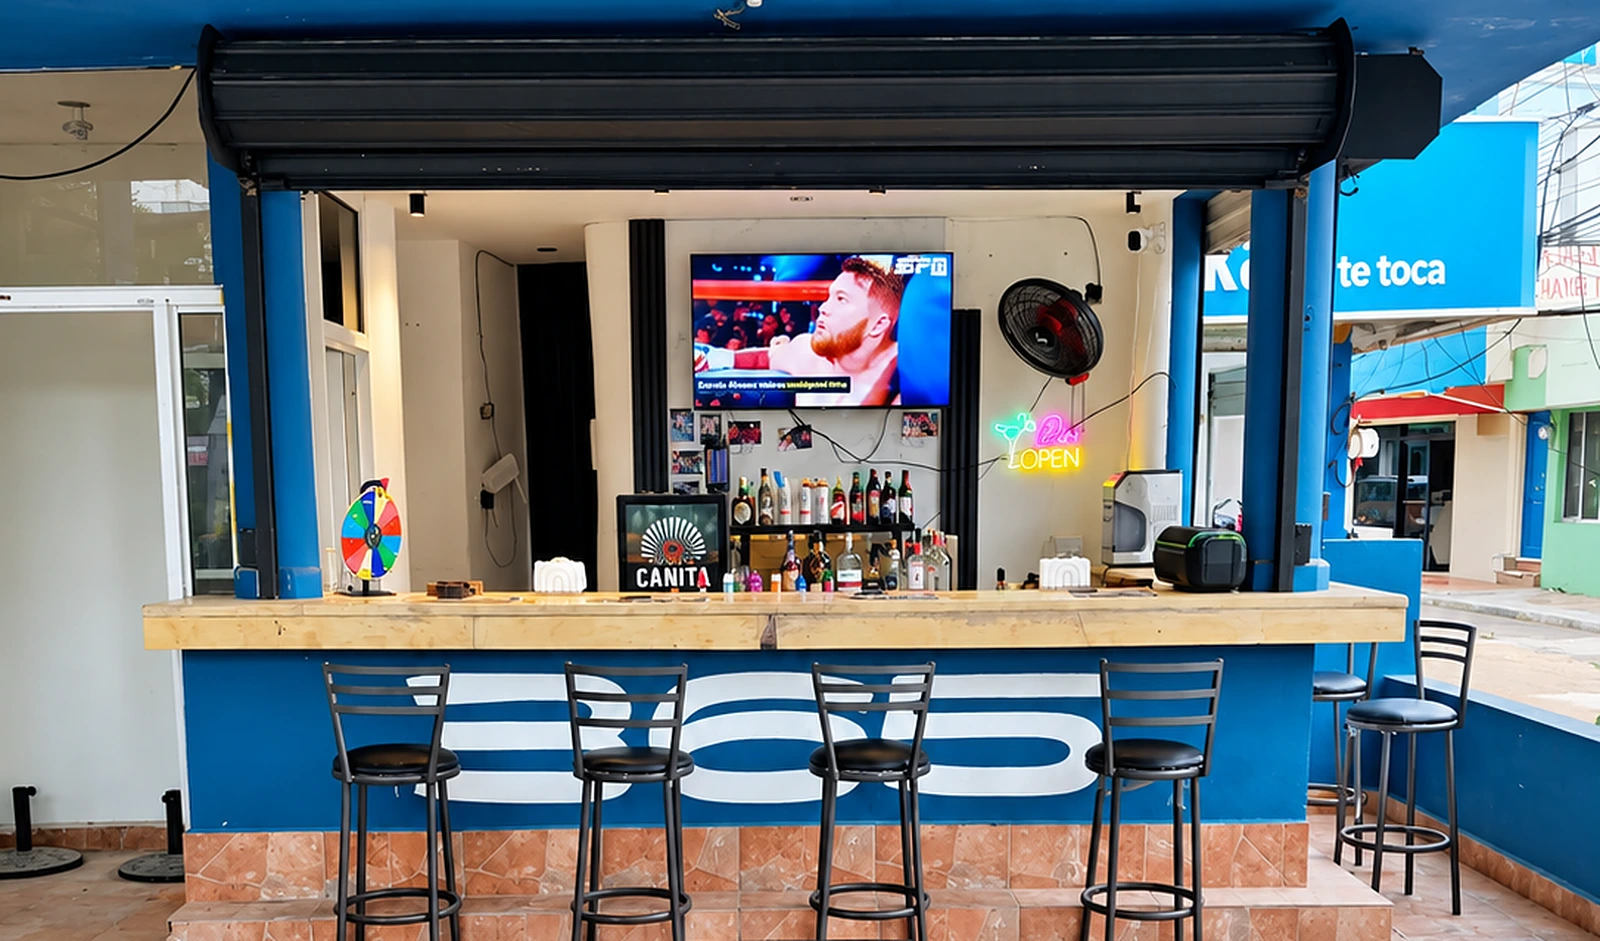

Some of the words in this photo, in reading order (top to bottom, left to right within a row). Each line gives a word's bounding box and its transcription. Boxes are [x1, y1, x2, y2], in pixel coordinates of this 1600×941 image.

[1337, 255, 1371, 288] te
[1376, 255, 1446, 287] toca
[1020, 448, 1080, 469] OPEN
[636, 566, 711, 588] CANITA
[406, 672, 1103, 803] 365
